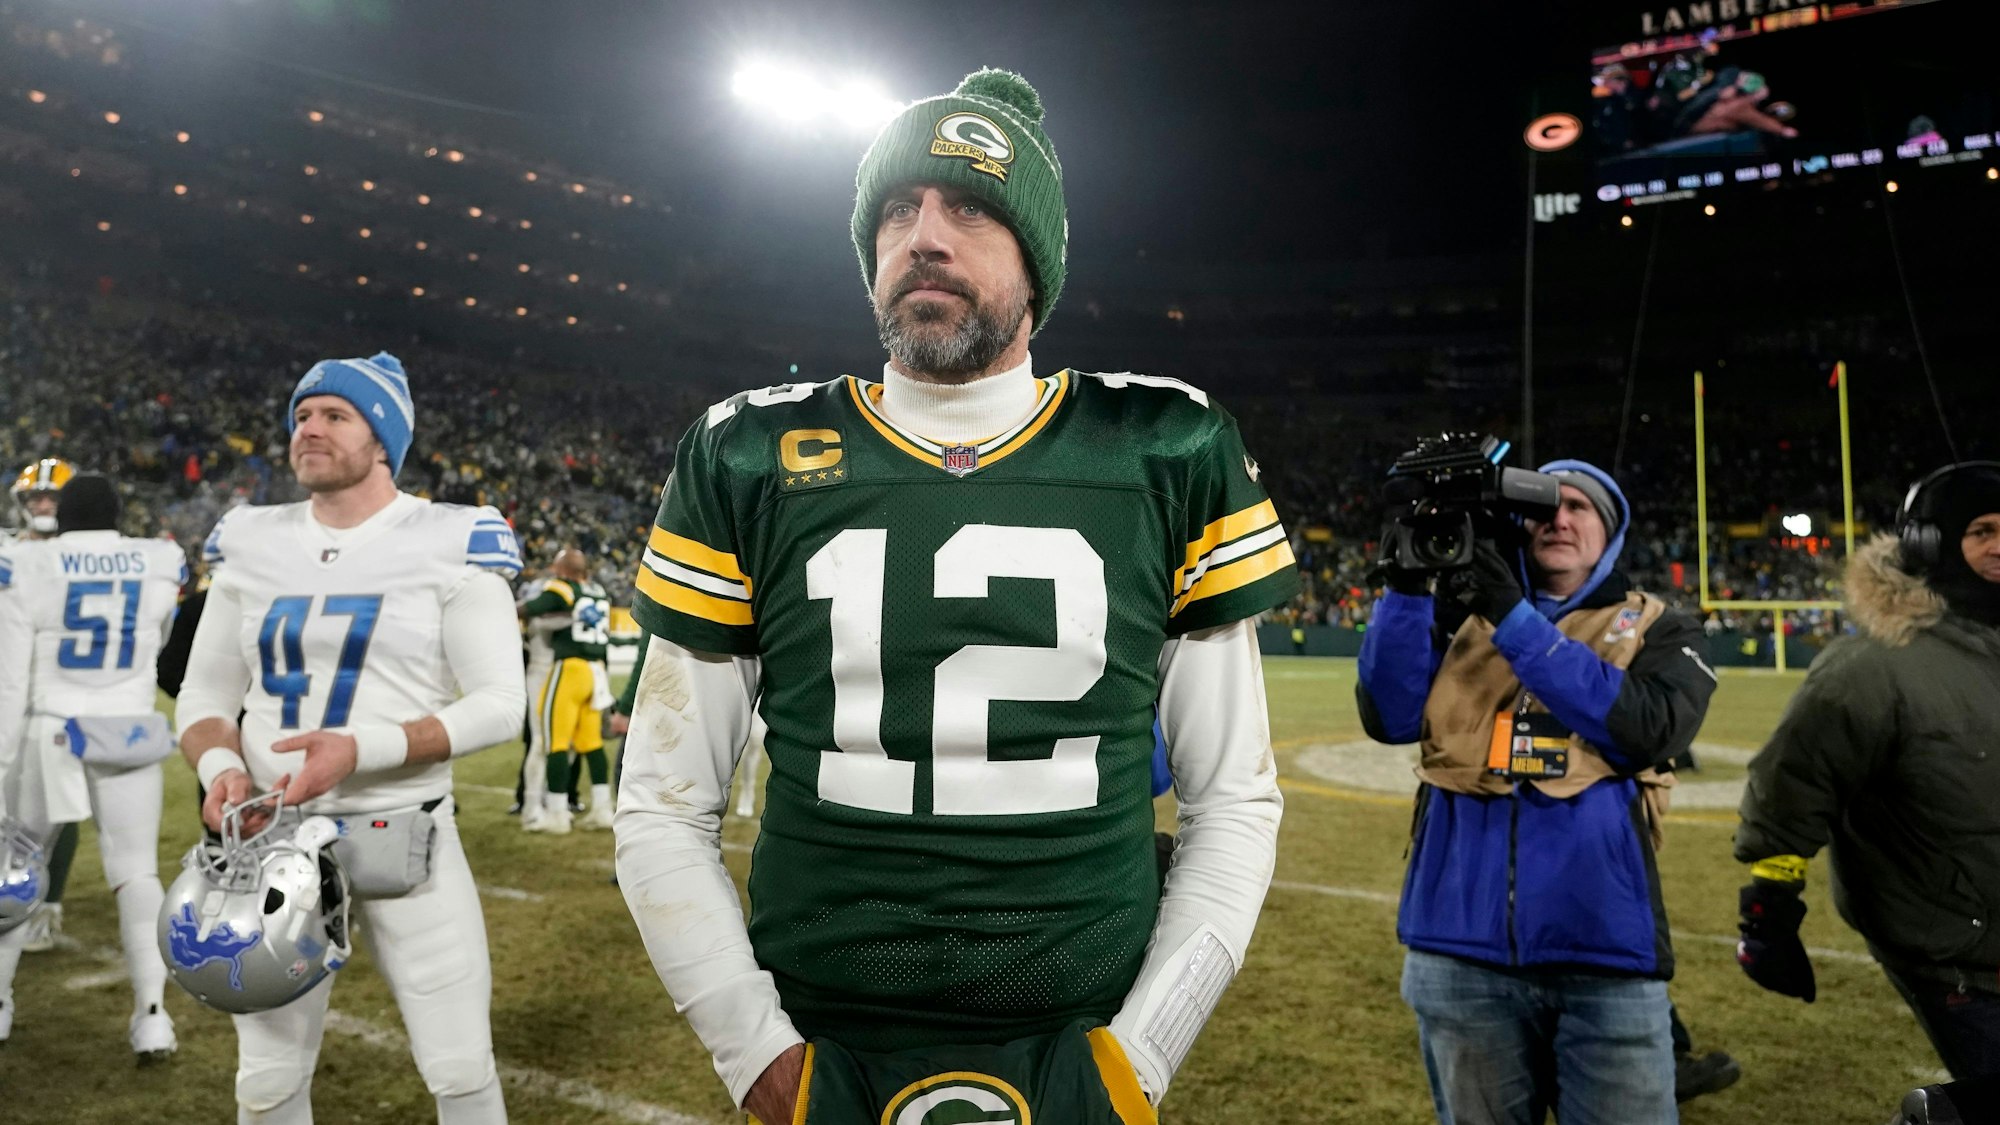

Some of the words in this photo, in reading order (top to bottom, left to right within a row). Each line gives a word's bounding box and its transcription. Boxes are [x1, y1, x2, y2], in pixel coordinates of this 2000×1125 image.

[1641, 0, 1816, 36] LAMBE
[932, 141, 985, 159] PACKERS
[984, 160, 1002, 174] NFC
[1534, 192, 1581, 222] Lite
[780, 428, 843, 473] C
[947, 455, 973, 469] NFL
[60, 551, 145, 575] WOODS
[57, 579, 143, 669] 51
[258, 593, 384, 730] 47
[806, 524, 1108, 816] 12
